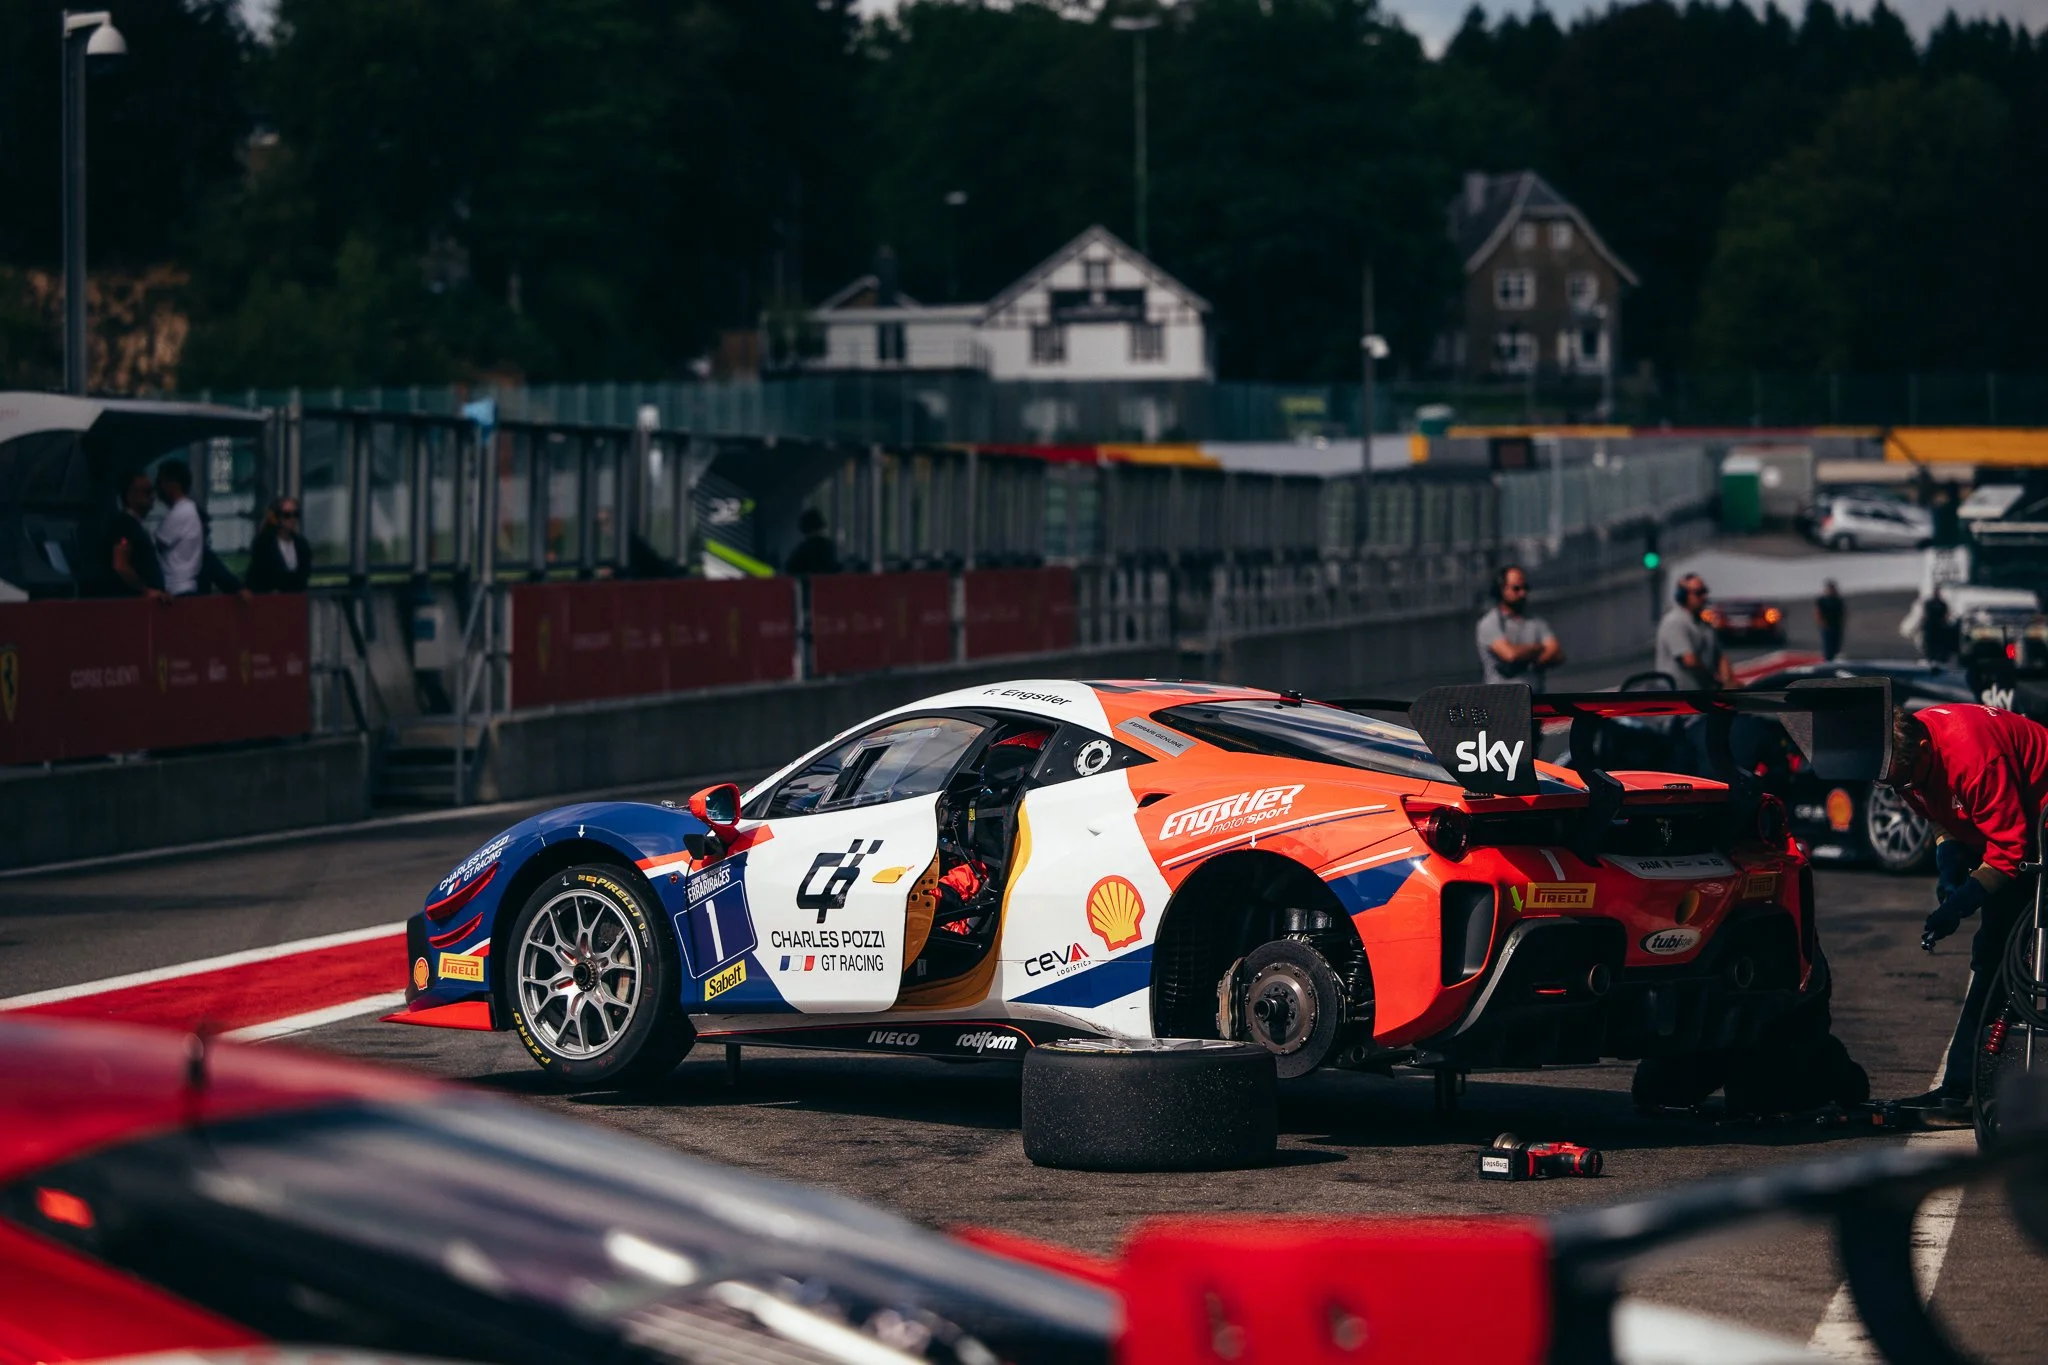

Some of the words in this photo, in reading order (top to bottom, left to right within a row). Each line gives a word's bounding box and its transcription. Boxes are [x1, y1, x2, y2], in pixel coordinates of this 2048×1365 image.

[1001, 689, 1072, 705] Engstler
[1129, 721, 1156, 736] FERRARI
[1154, 732, 1184, 749] GENUINE
[1456, 730, 1524, 781] sky
[1159, 784, 1305, 840] Engstler
[1210, 803, 1293, 835] motorsport
[439, 853, 480, 891] CHARLES
[480, 835, 510, 860] POZZI
[464, 868, 476, 882] GT
[475, 848, 502, 875] RACING
[597, 878, 640, 917] PIRELLI
[684, 868, 731, 904] ERRARIRACES
[1534, 888, 1588, 904] PIRELLI
[705, 899, 725, 962] 1
[771, 930, 839, 948] CHARLES
[842, 930, 885, 948] POZZI
[1652, 935, 1683, 949] tubi
[442, 958, 479, 977] PIRELLI
[821, 954, 836, 972] GT
[840, 954, 884, 972] RACING
[709, 965, 742, 997] Sabelt
[868, 1030, 920, 1046] IVECO
[955, 1031, 1016, 1053] rotiform
